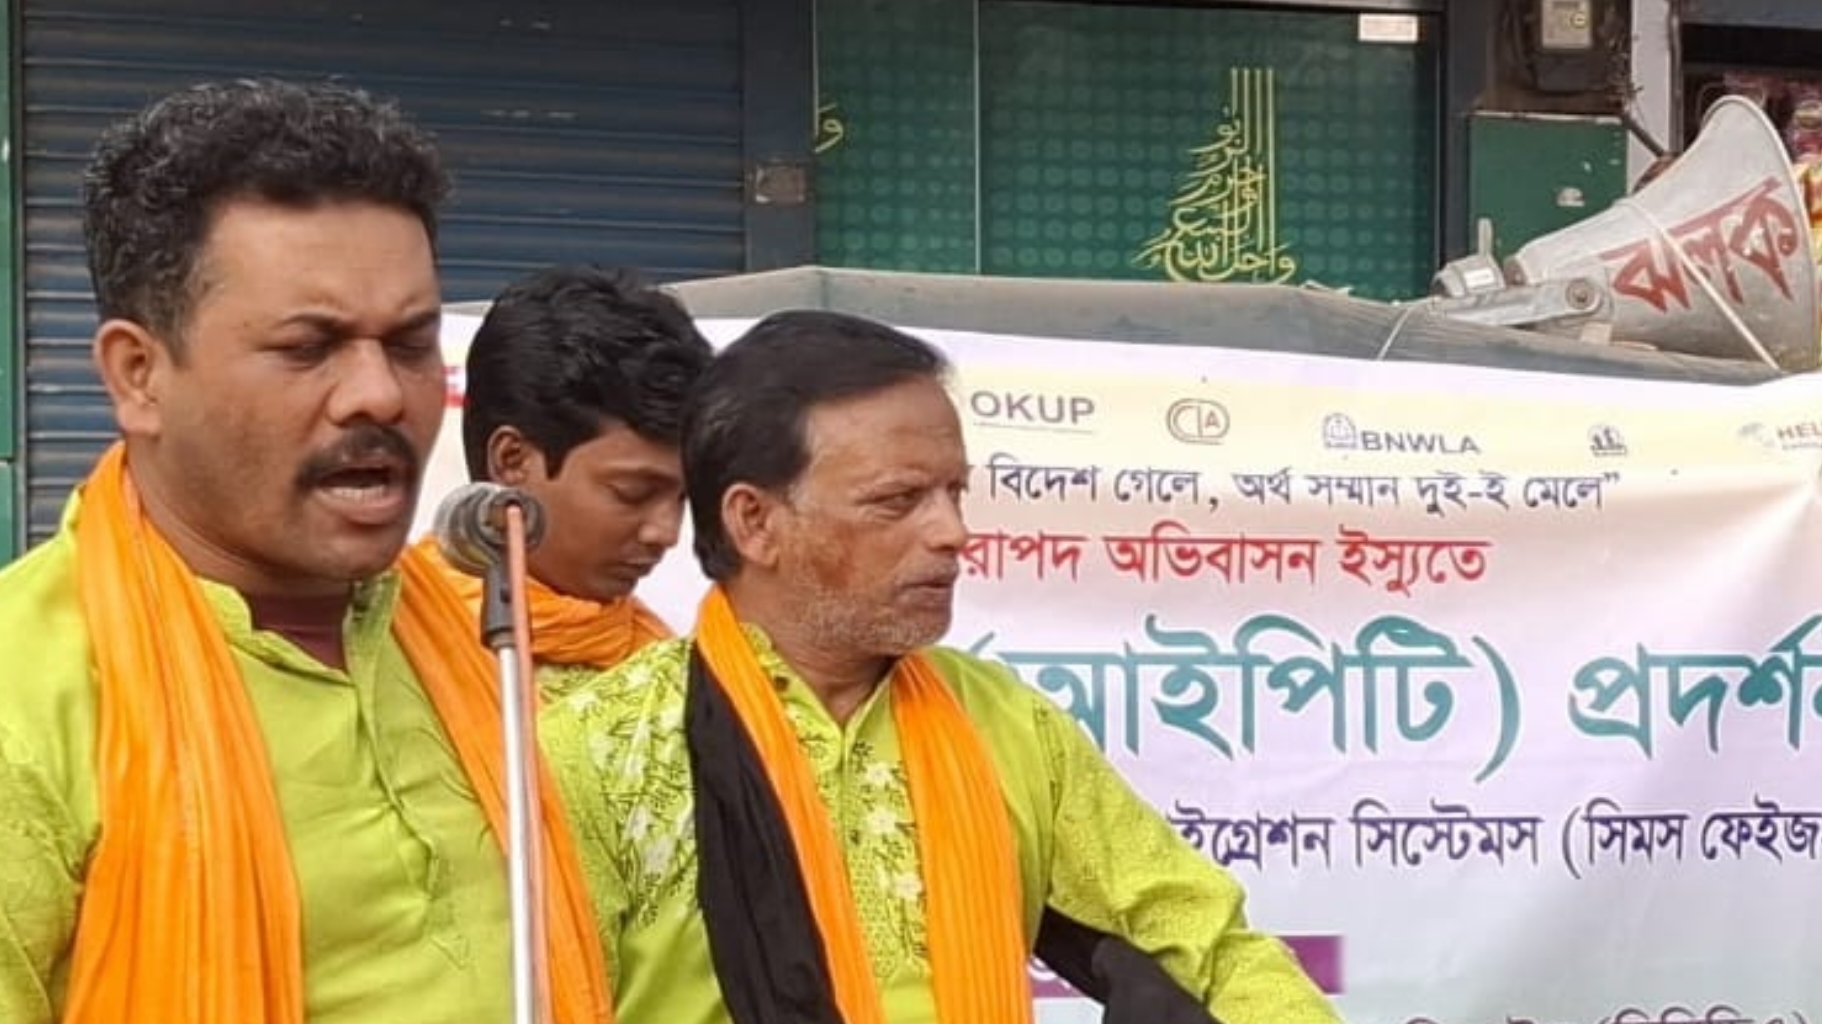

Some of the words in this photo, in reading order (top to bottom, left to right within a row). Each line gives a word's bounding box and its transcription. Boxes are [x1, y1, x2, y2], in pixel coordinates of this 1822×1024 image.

[970, 391, 1096, 425] OKUP
[1361, 431, 1482, 455] BNWLA
[985, 451, 1101, 502] বিদেশ
[1232, 467, 1291, 506] অর্থ
[1412, 470, 1510, 517] দুই-ই
[963, 530, 1089, 583] রাপদ
[1102, 520, 1321, 585] অভিবাসন
[1336, 524, 1494, 597] ইস্যুতে
[1166, 799, 1337, 871] ইগ্রেশন
[1348, 799, 1546, 868] সিস্টেমস
[1562, 797, 1691, 880] (সিমস
